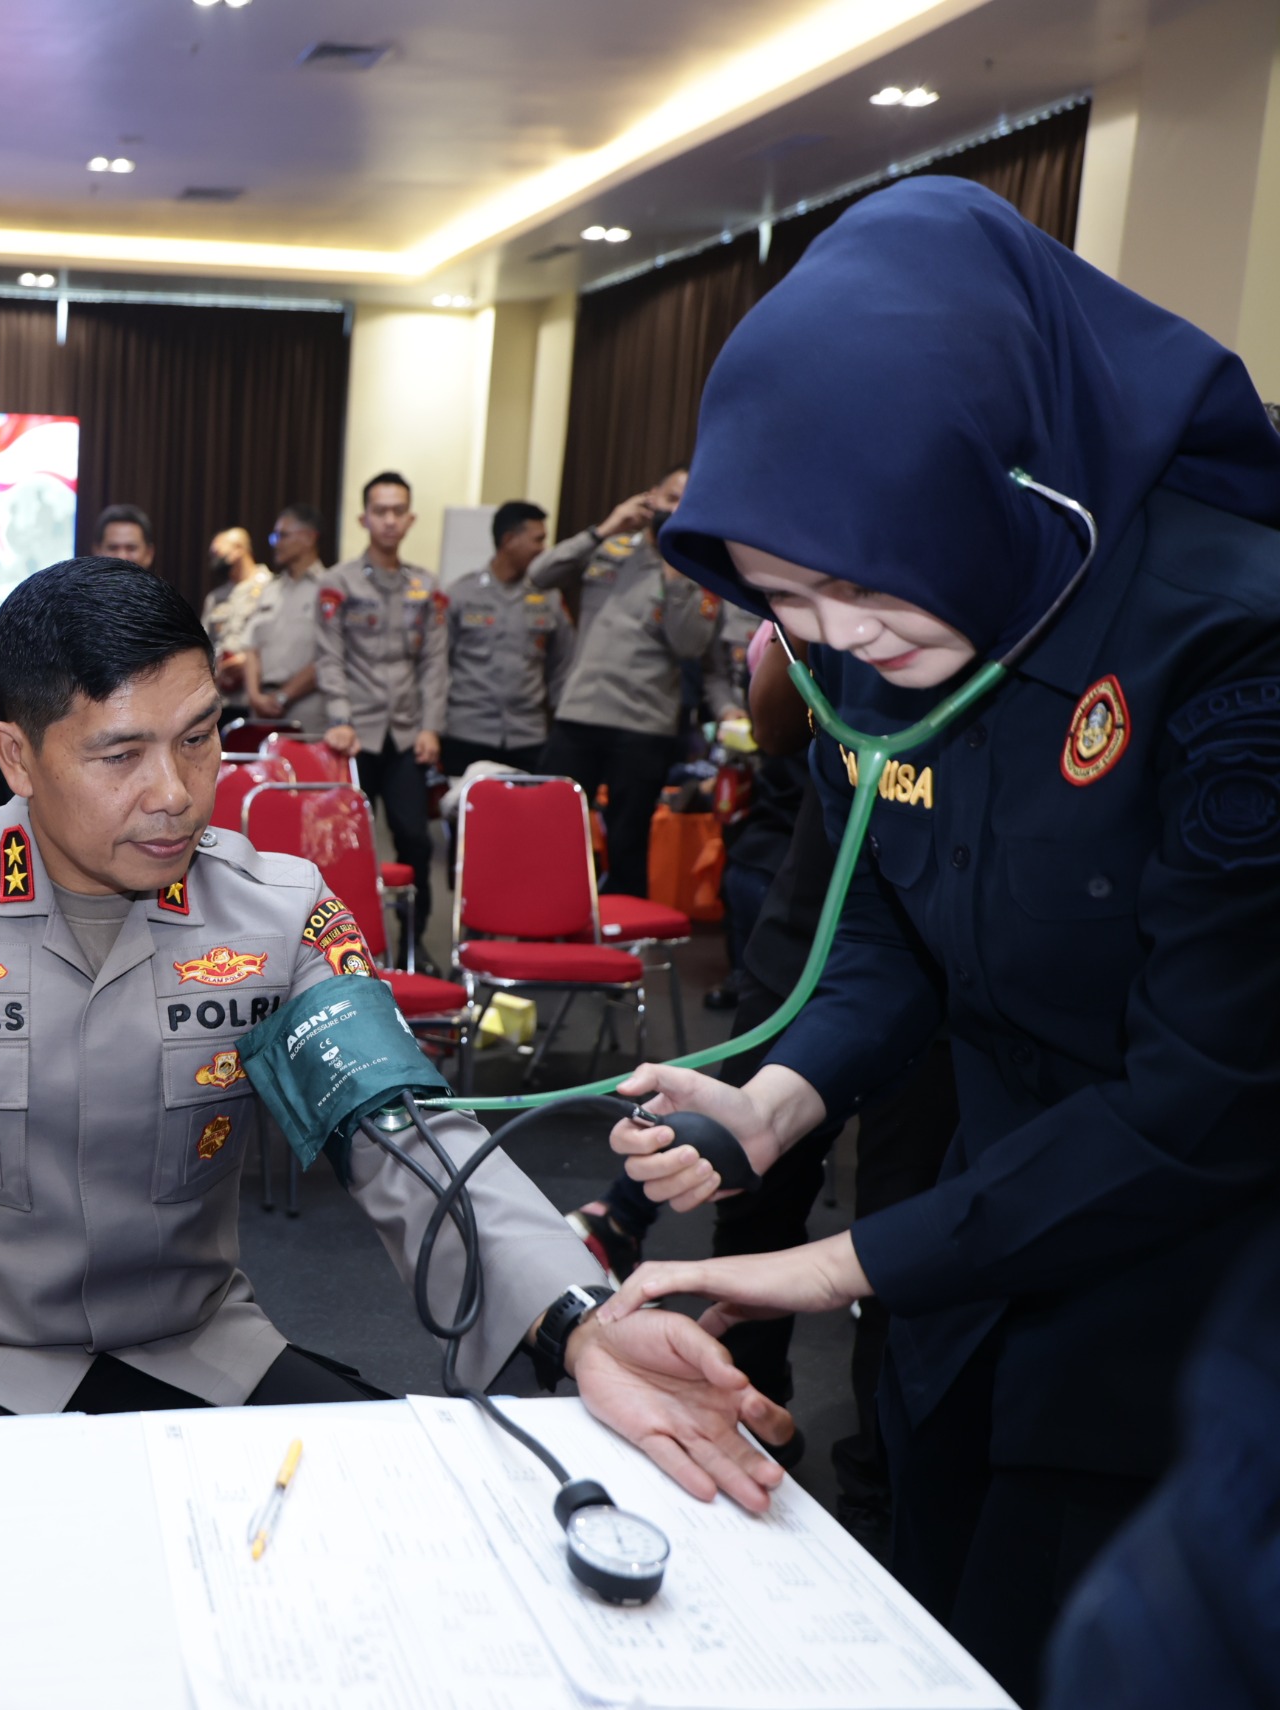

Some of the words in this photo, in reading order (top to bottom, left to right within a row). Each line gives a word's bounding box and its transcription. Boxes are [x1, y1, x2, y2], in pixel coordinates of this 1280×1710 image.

[303, 899, 348, 941] POLDA
[167, 995, 280, 1032] POLRI
[287, 1010, 329, 1053] ABN
[306, 1017, 340, 1041] PRESSURE
[339, 1010, 357, 1022] CUFF
[317, 1056, 389, 1107] www.abnmedical.com
